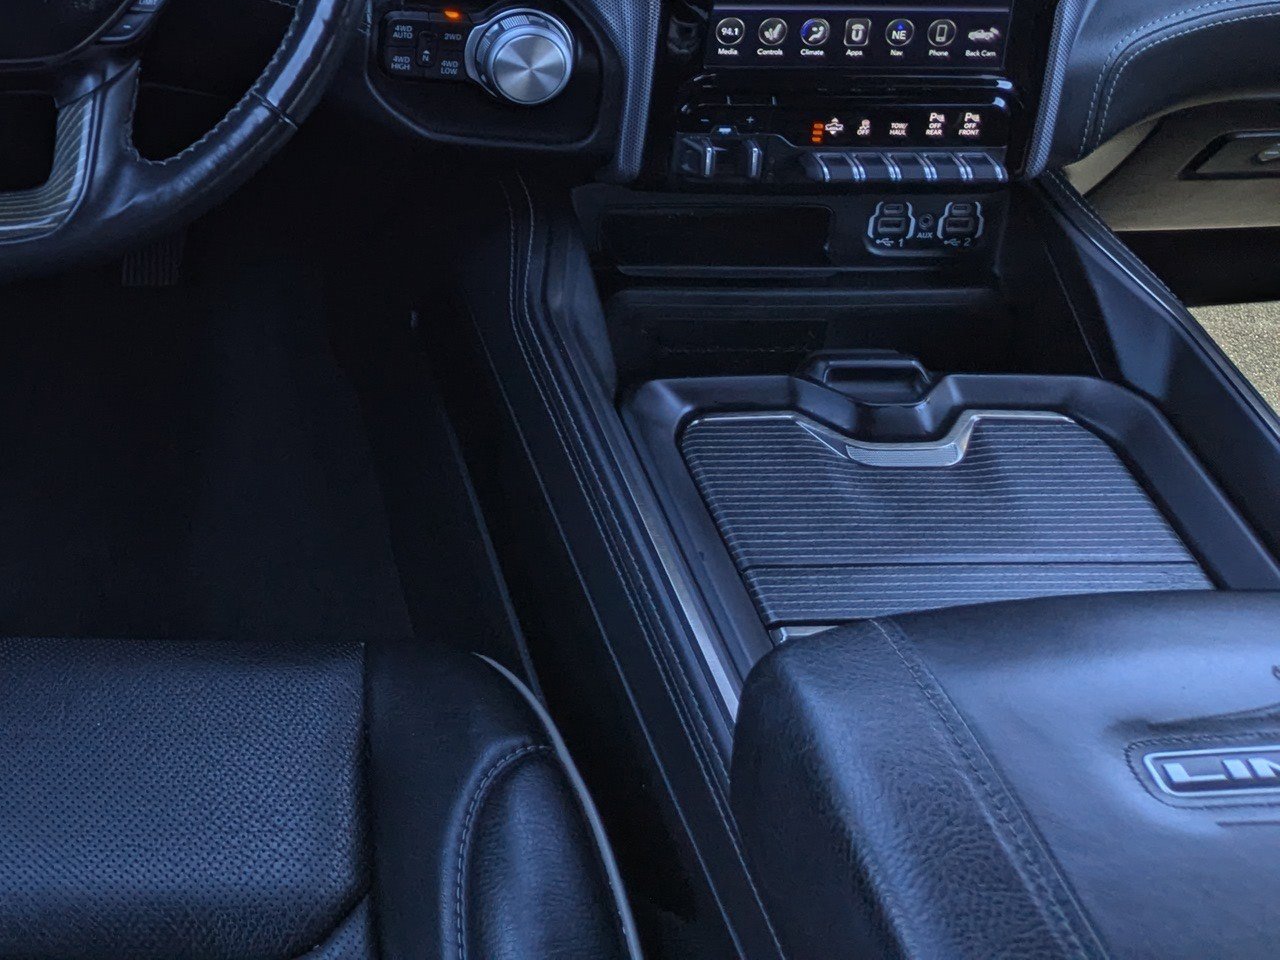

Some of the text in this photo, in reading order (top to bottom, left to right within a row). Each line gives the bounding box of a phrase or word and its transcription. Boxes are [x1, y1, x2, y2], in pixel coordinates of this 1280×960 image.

[721, 27, 739, 36] 94.1
[891, 30, 907, 40] NE
[757, 48, 783, 56] Controls
[845, 49, 863, 57] Apps
[965, 49, 980, 57] Back
[422, 54, 430, 62] N
[441, 60, 459, 68] 4WD
[963, 238, 971, 247] 2
